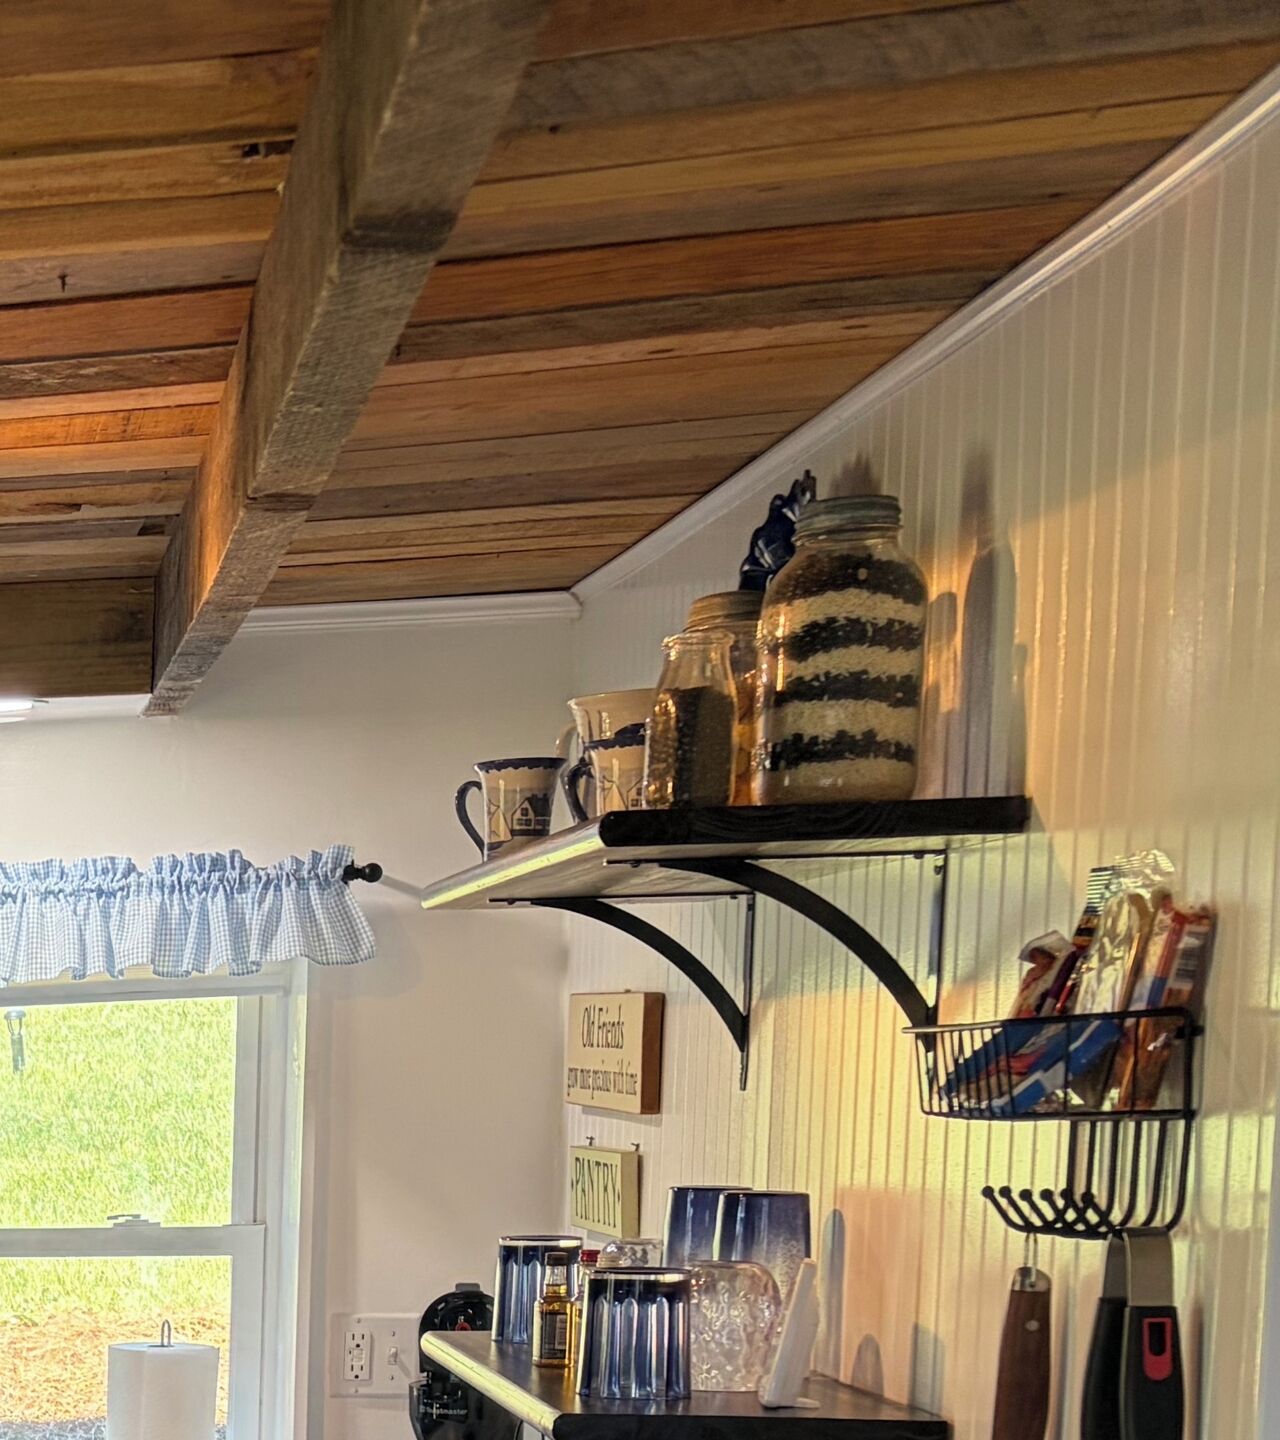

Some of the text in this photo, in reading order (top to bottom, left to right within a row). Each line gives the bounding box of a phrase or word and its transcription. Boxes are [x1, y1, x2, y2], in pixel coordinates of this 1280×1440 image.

[582, 1003, 625, 1050] Old Friends
[574, 1157, 618, 1228] PANTRY
